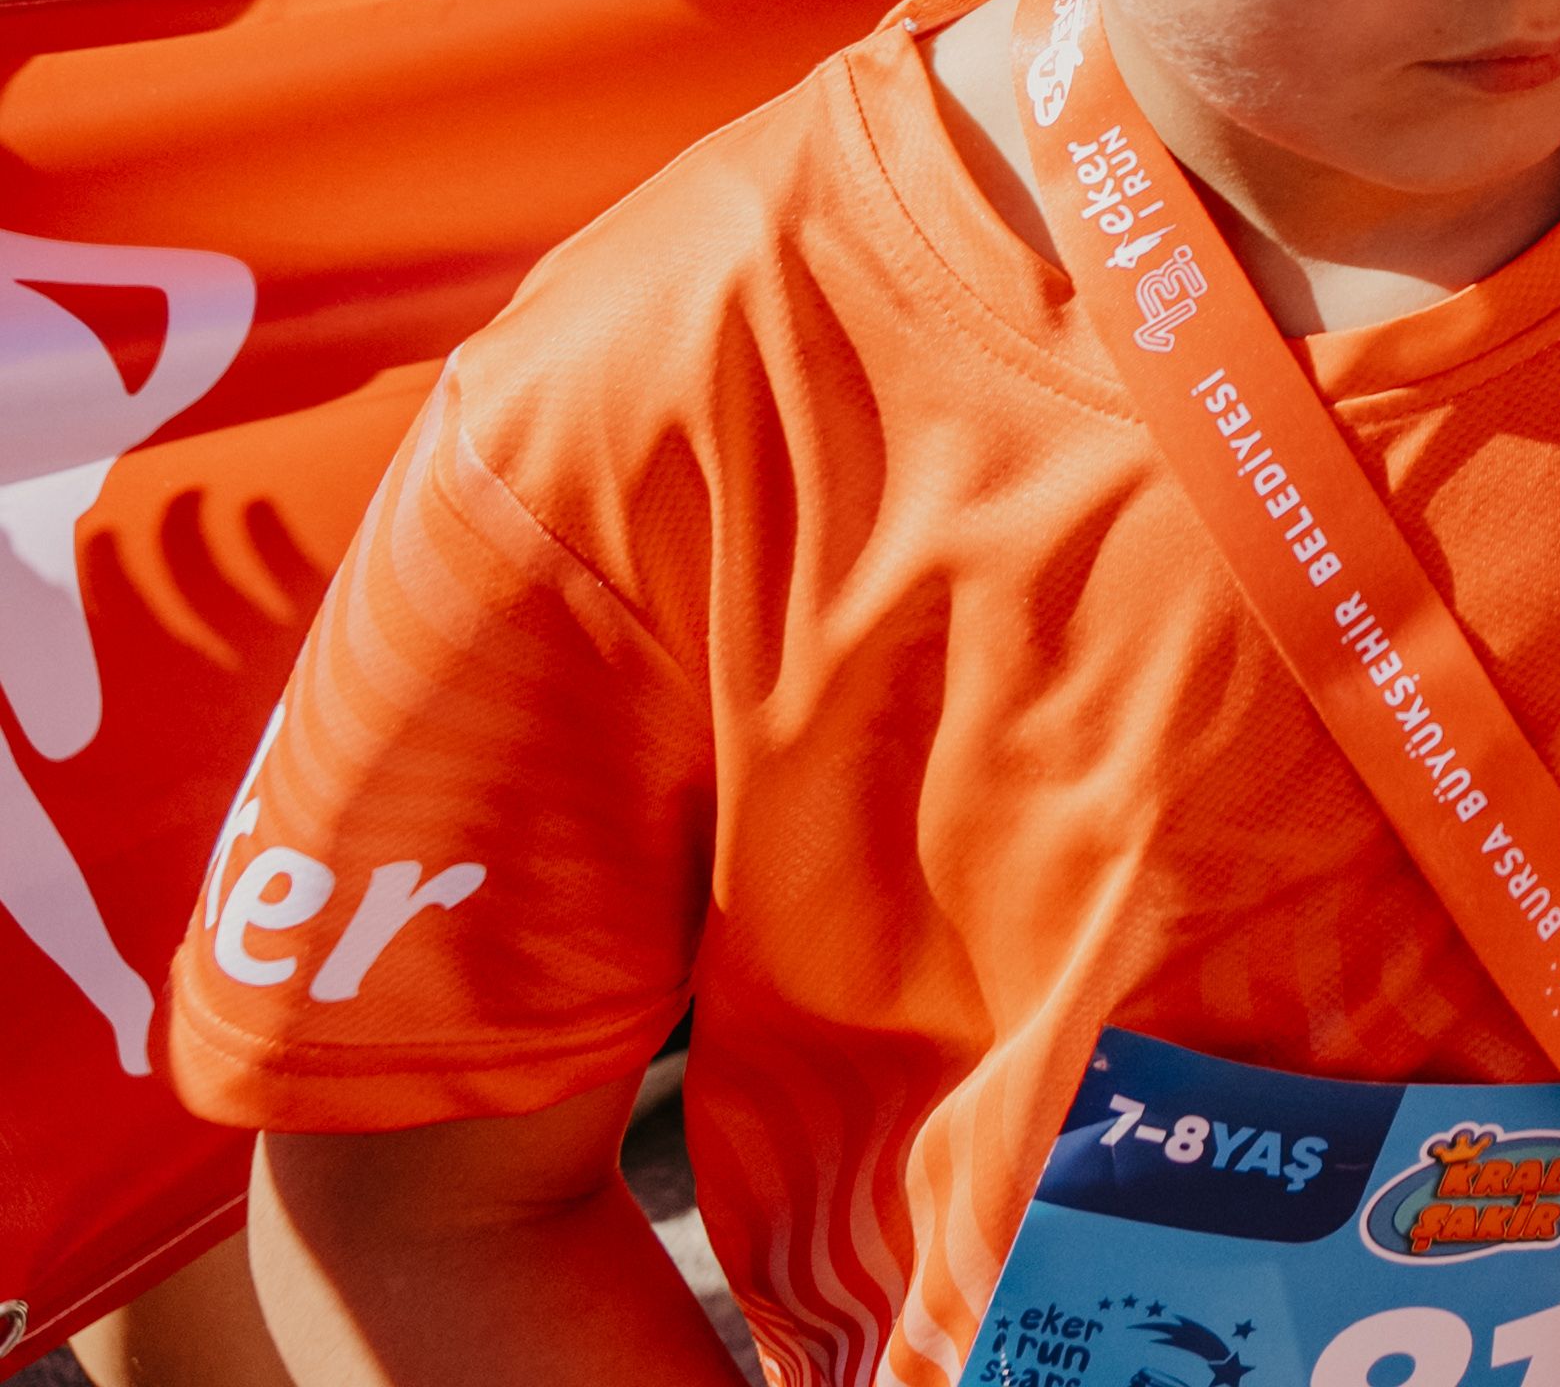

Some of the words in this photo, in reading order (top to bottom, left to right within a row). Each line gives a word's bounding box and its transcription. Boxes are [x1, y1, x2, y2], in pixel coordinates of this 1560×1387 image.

[1066, 140, 1136, 236] eker
[1099, 125, 1153, 201] RUN
[1190, 367, 1343, 588] BELEDİYESİ
[1334, 589, 1489, 824] BÜYÜKŞEHİR
[1015, 1335, 1093, 1372] run
[1020, 1302, 1104, 1341] eker
